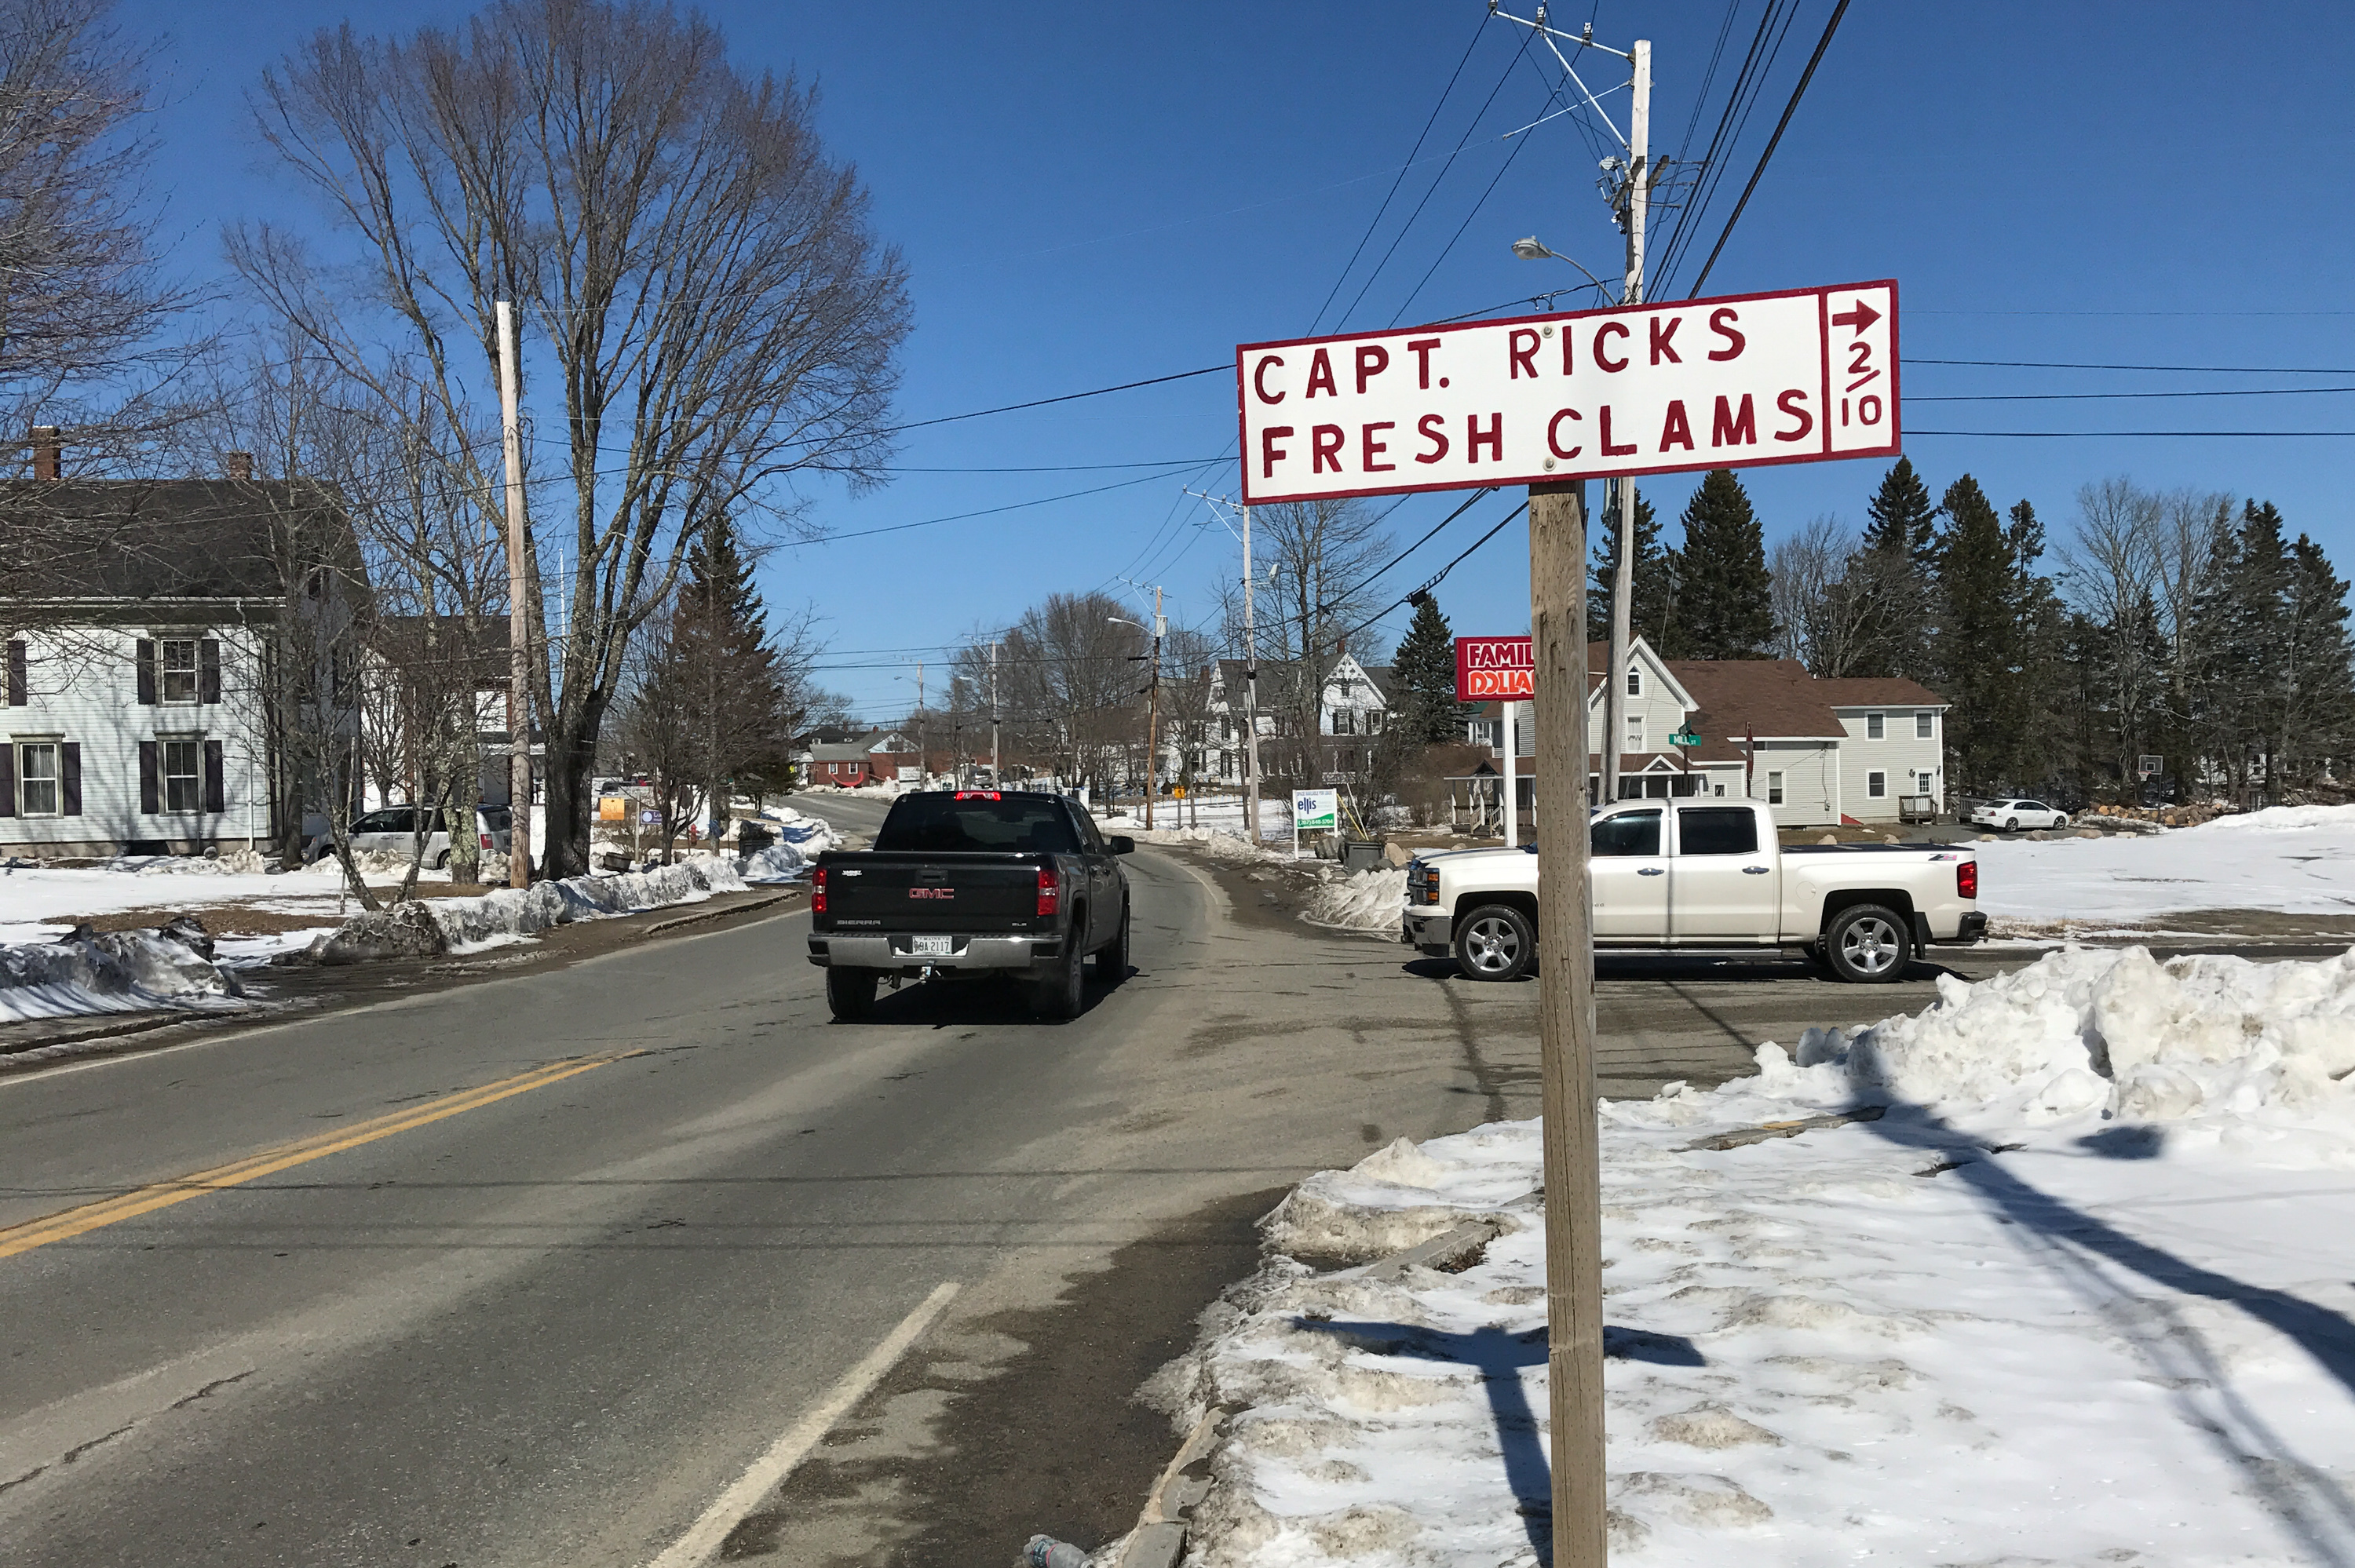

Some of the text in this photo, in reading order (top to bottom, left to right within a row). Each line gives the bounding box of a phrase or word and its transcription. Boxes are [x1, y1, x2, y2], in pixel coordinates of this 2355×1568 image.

[1255, 308, 1747, 405] CAPT. RICKS
[1262, 389, 1813, 478] FRESH CLAMS
[1467, 643, 1534, 668] FAMIL
[1468, 670, 1535, 695] DOLLA
[1298, 797, 1316, 815] ellis
[908, 888, 955, 899] GMC
